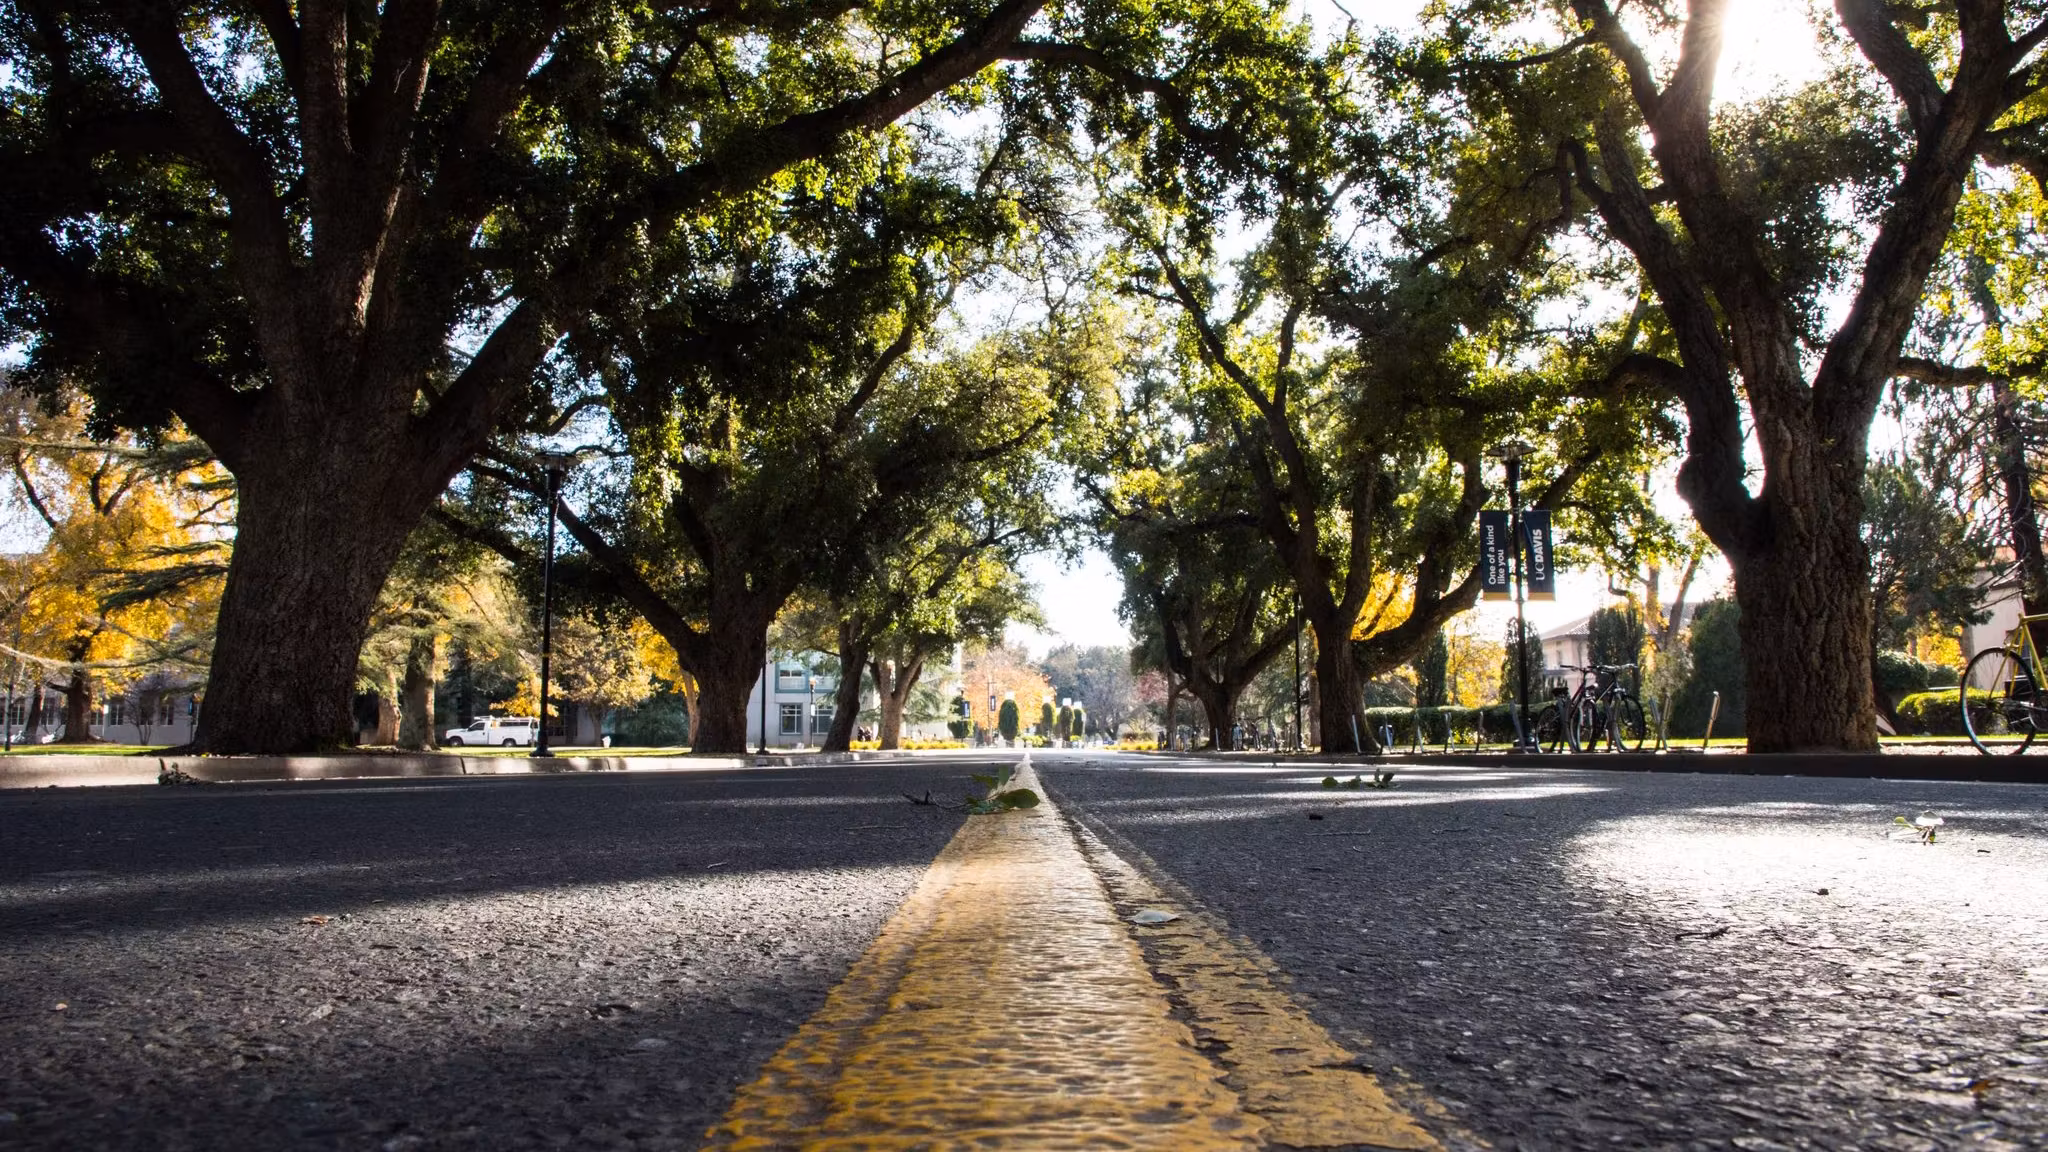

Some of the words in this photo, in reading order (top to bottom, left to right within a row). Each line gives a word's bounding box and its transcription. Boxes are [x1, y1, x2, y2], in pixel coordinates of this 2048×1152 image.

[1485, 525, 1494, 545] kind
[1486, 553, 1495, 564] of
[1497, 549, 1506, 566] you
[1488, 566, 1496, 585] One
[1497, 568, 1505, 585] like
